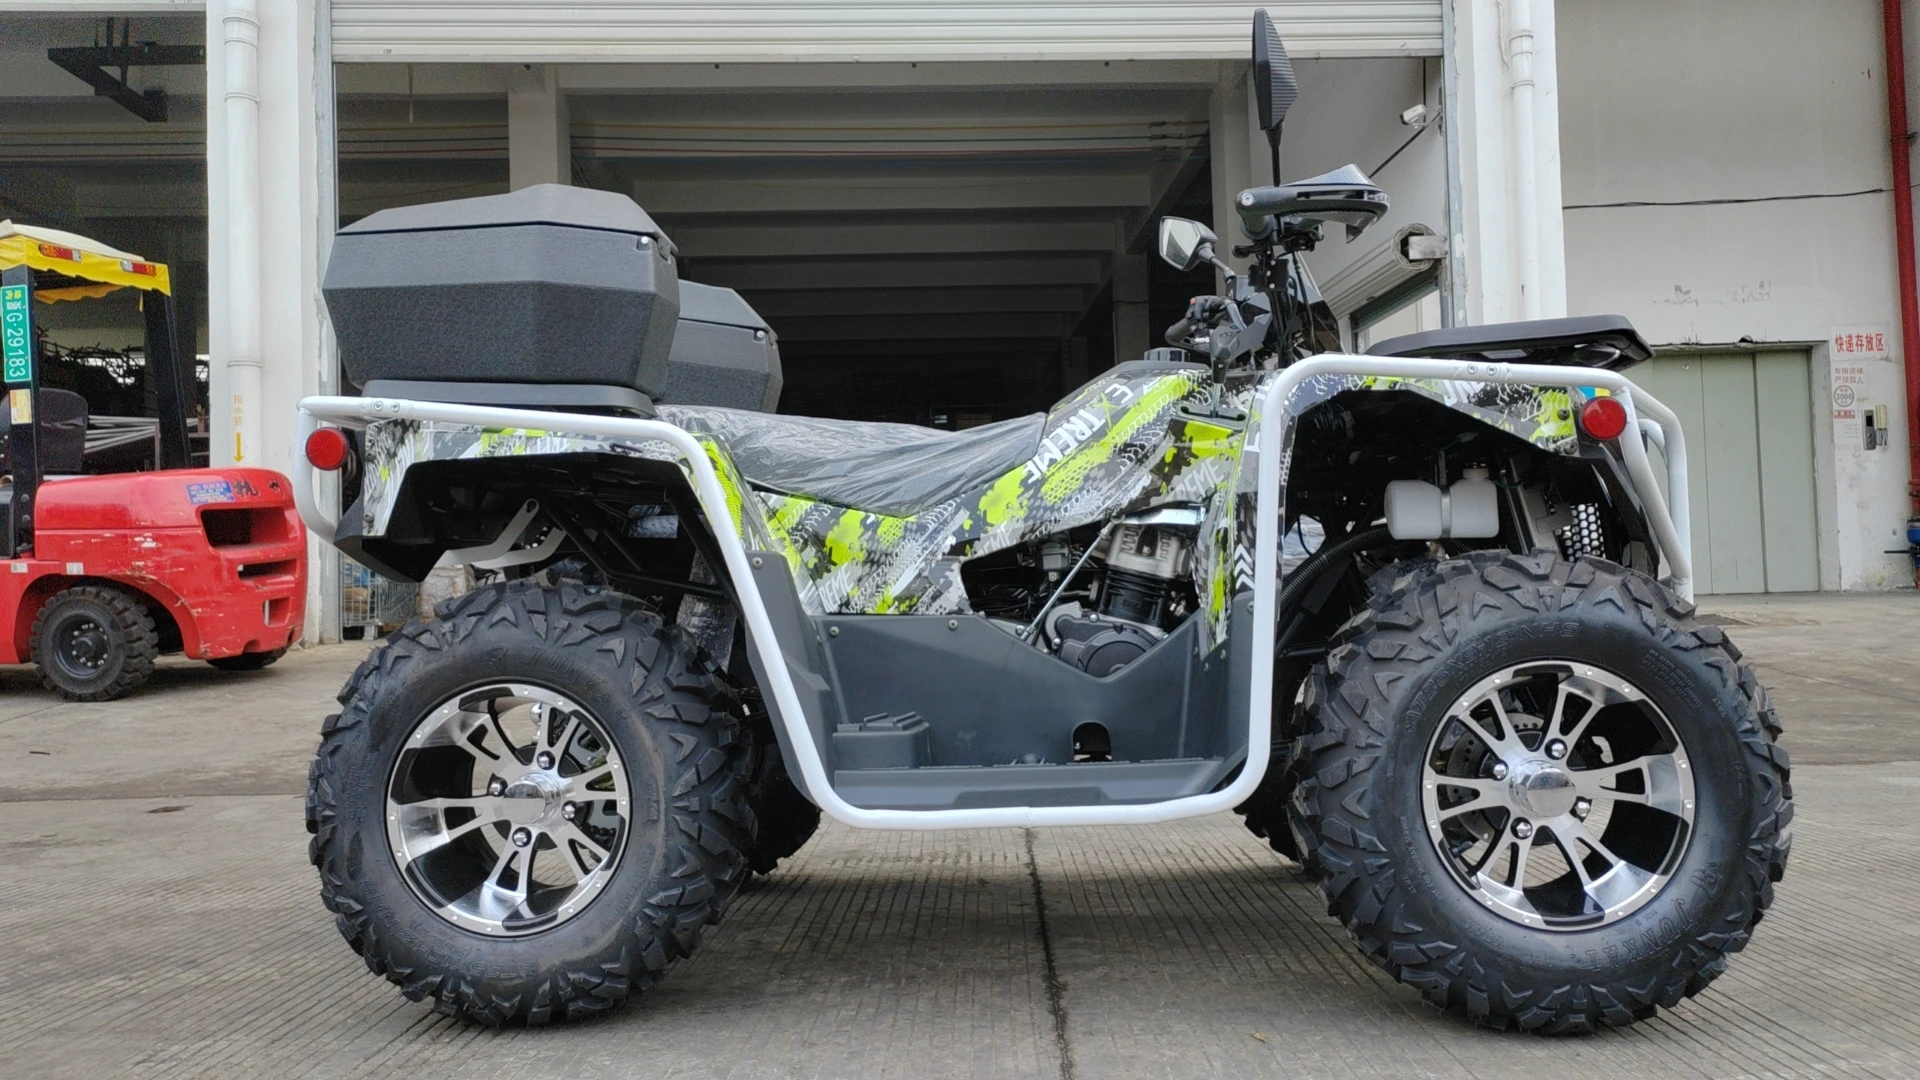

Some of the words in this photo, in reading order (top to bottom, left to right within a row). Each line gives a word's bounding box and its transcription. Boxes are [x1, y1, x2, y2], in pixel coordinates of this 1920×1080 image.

[1834, 333, 1885, 353] 快递存放区
